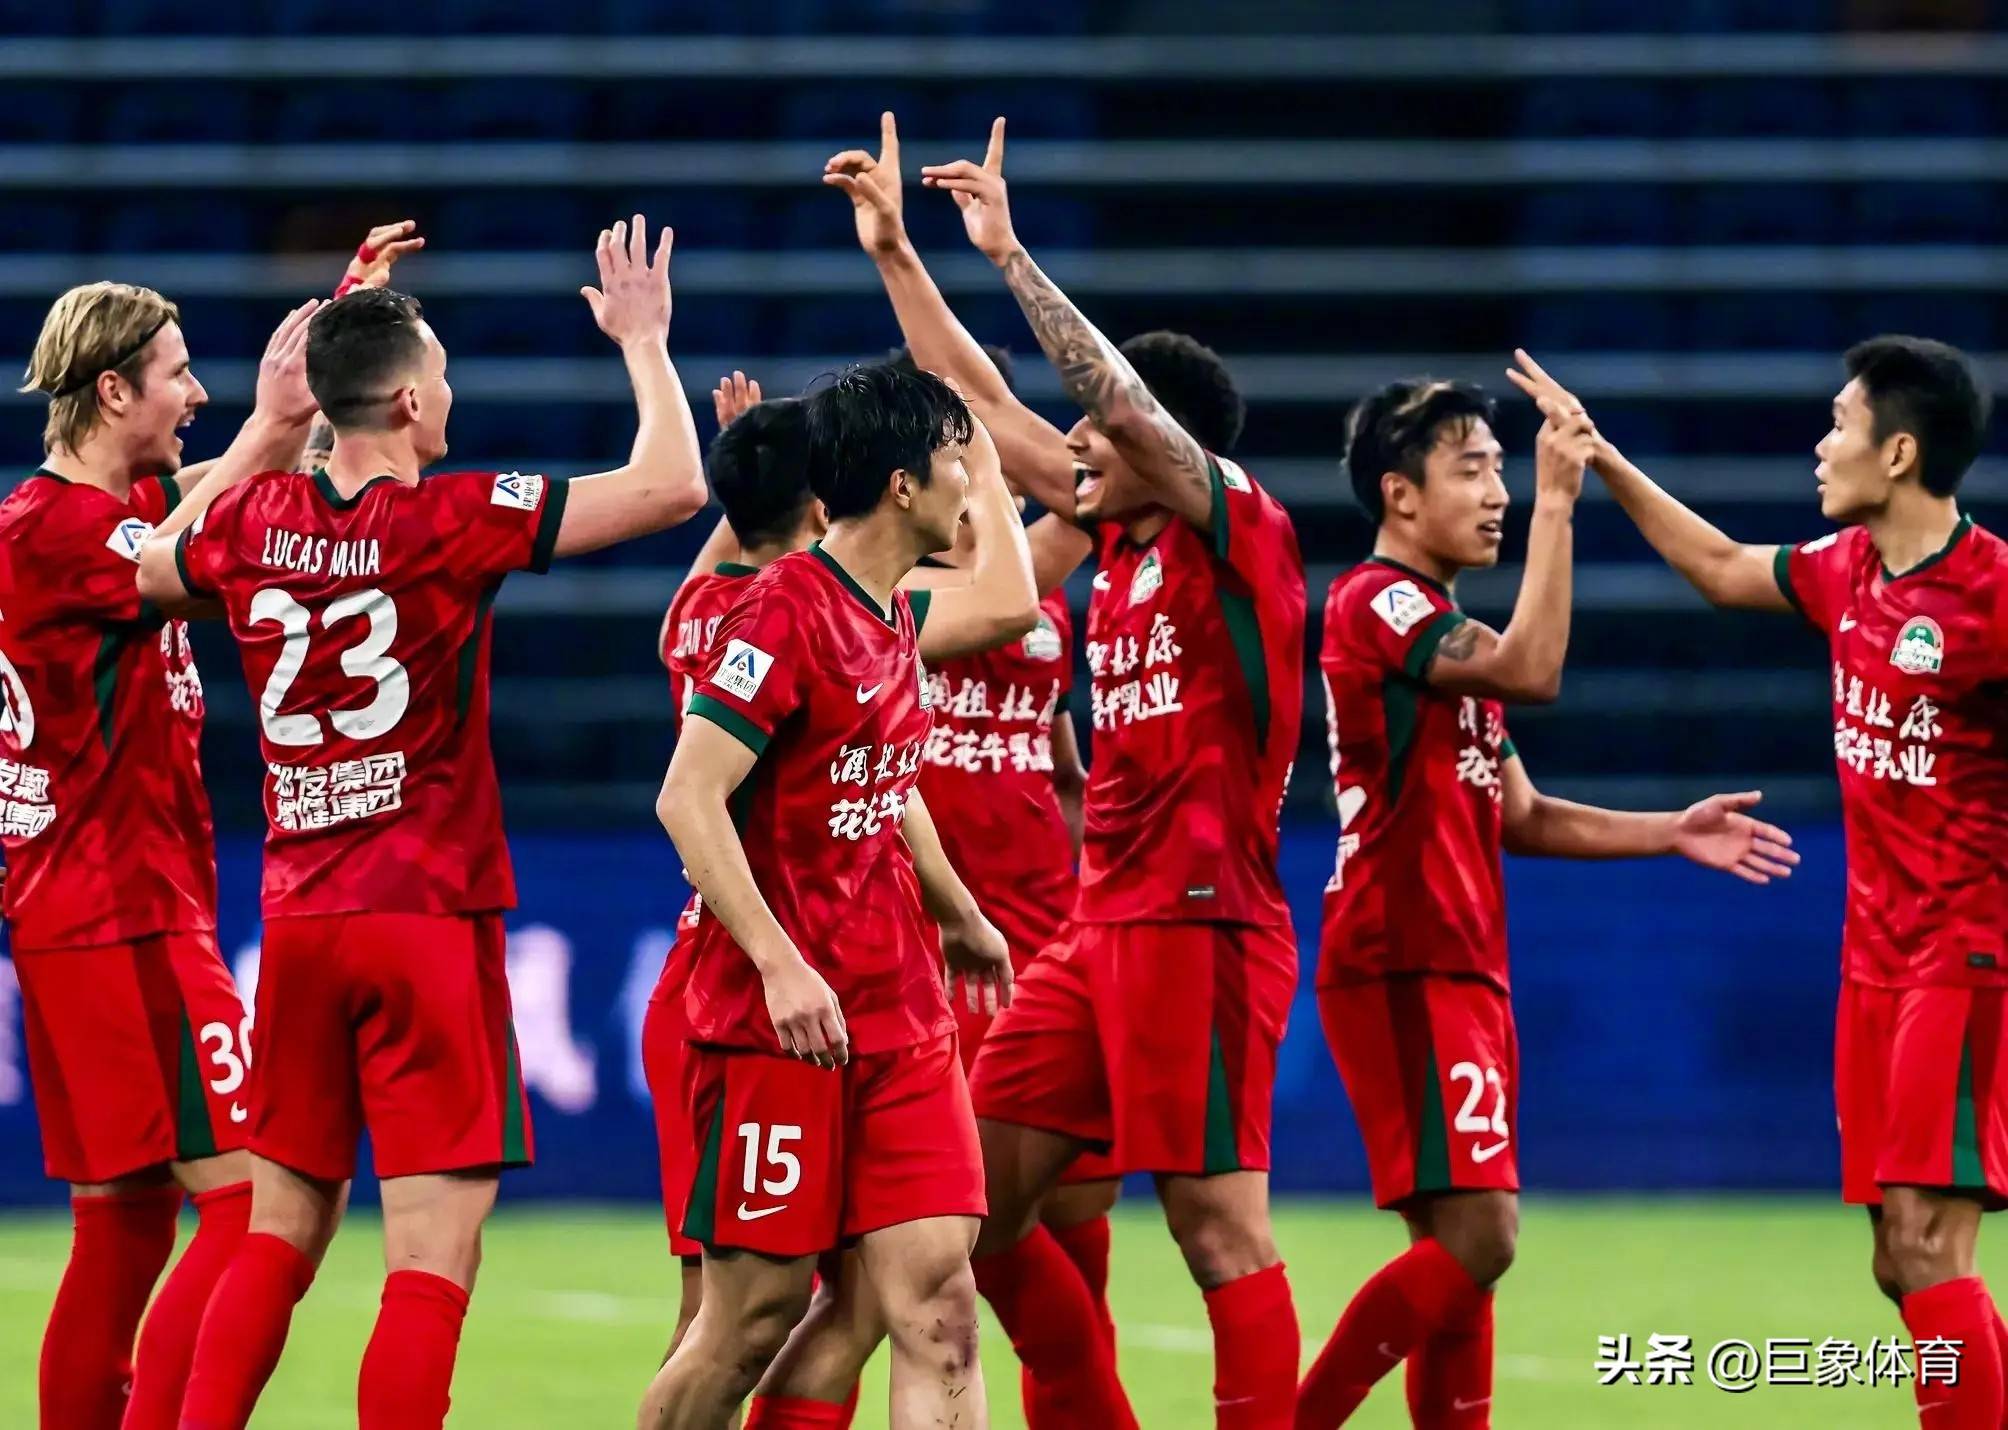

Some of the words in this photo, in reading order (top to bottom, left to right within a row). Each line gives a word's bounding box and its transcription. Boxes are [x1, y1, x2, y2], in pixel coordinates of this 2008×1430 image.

[262, 527, 328, 574] LUCAS
[328, 538, 380, 577] MAIA
[249, 588, 410, 746] 23
[737, 1122, 803, 1197] 15
